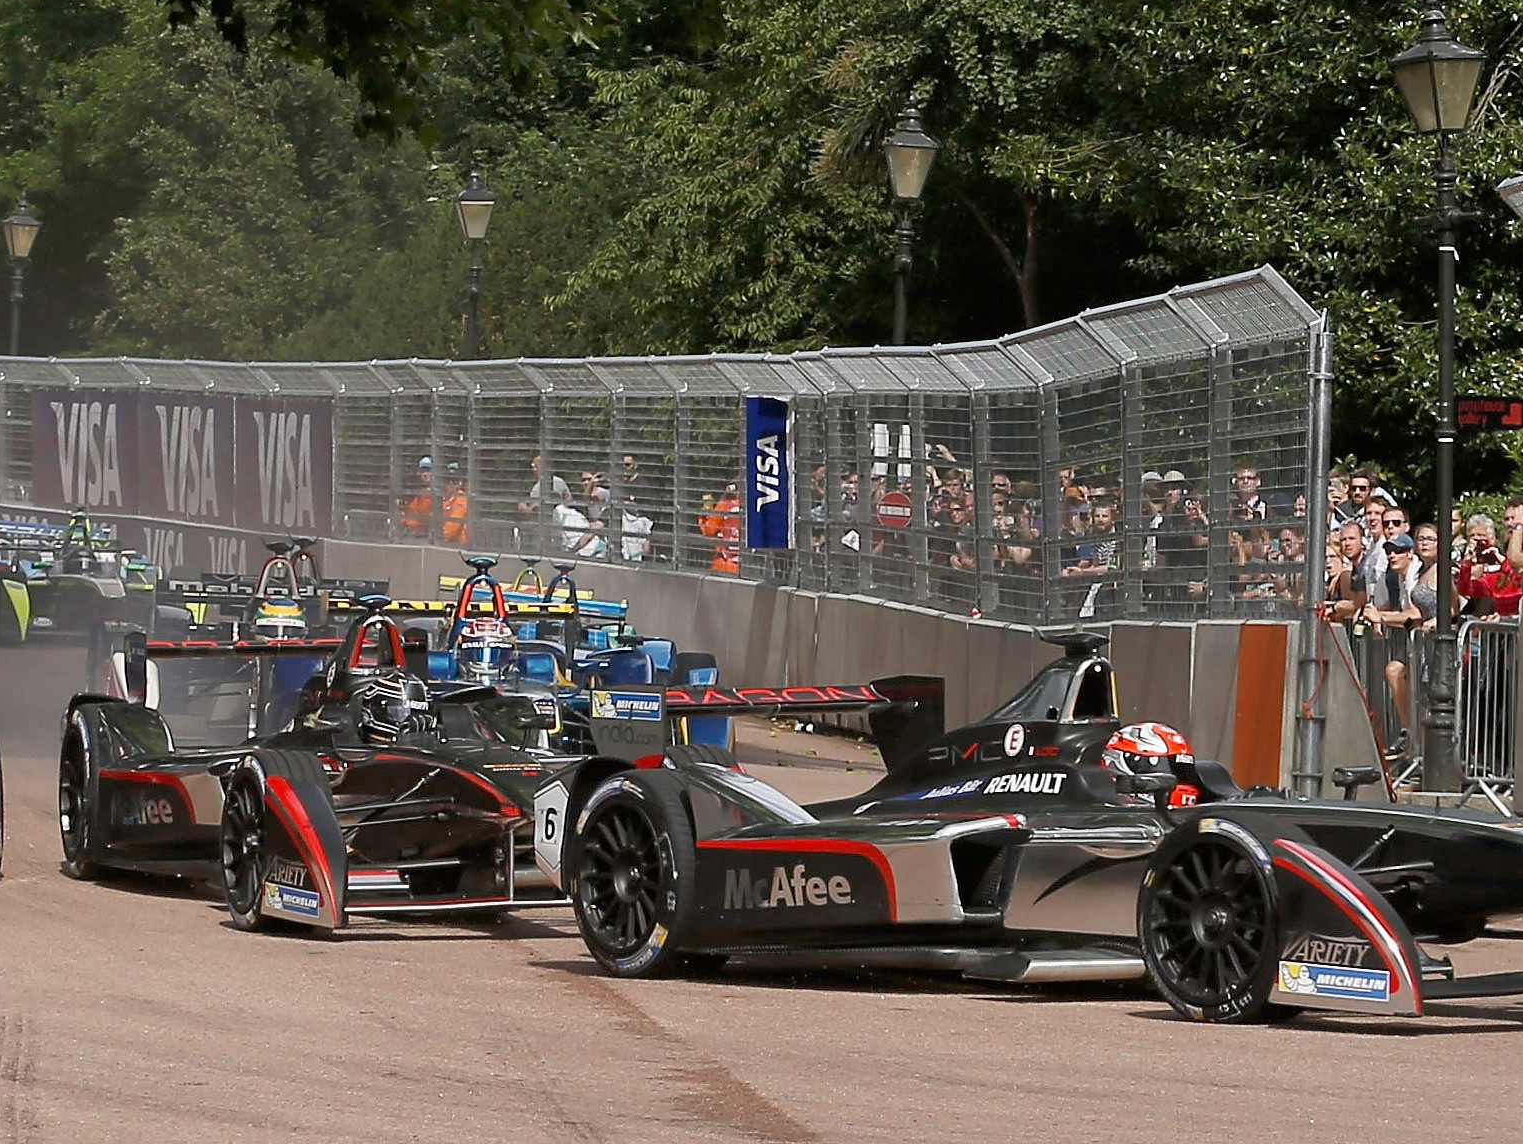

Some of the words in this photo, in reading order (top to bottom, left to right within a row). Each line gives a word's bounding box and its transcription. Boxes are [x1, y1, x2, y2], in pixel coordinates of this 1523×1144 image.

[50, 401, 123, 508] VISA
[155, 404, 220, 518] VISA
[253, 410, 316, 529] VISA
[756, 434, 780, 513] VISA
[616, 699, 660, 712] MICHELIN
[983, 773, 1067, 795] RENAULT
[544, 807, 556, 841] 6
[283, 893, 318, 909] MICHELIN
[723, 864, 852, 909] McAfee
[1316, 973, 1387, 990] MICHELIN
